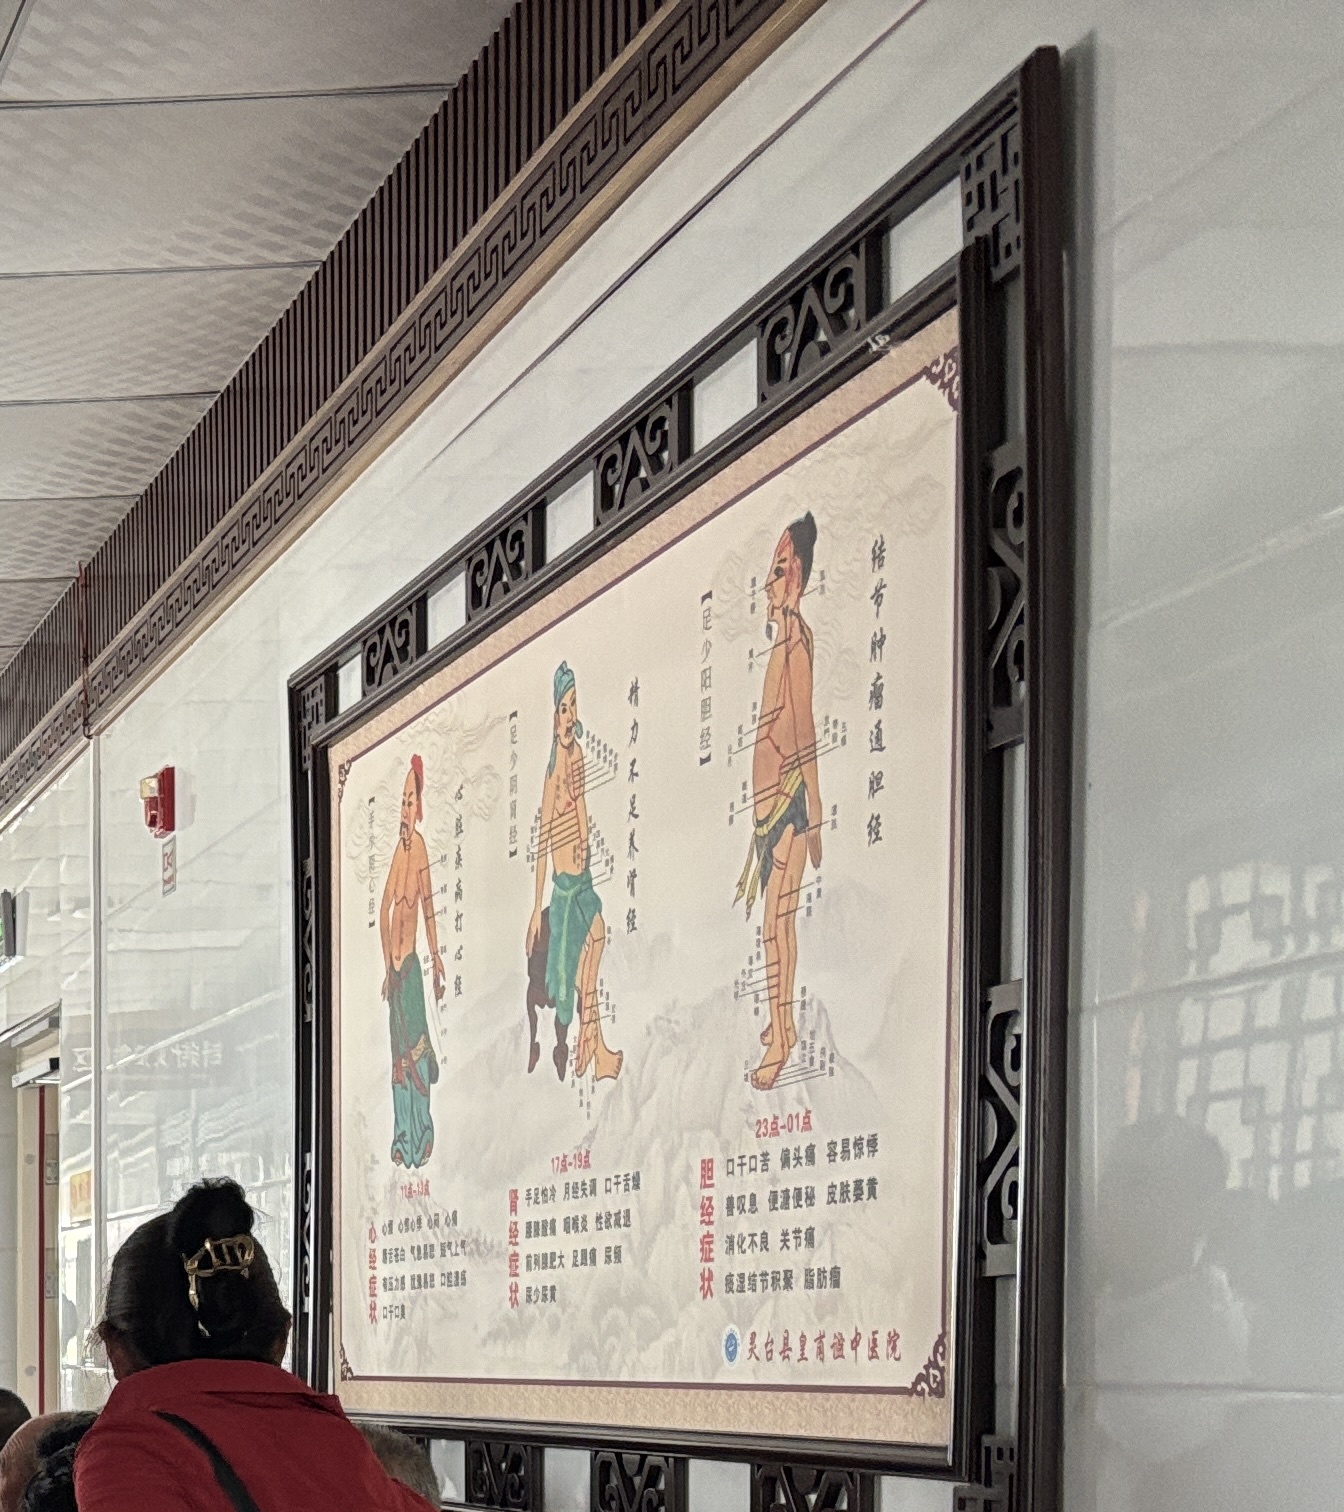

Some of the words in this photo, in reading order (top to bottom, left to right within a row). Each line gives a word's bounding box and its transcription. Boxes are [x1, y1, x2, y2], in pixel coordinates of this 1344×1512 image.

[755, 1108, 813, 1138] 23点-01点
[726, 1151, 770, 1177] 口干口苦
[780, 1143, 816, 1171] 偏头痛
[563, 1177, 597, 1201] 月经失调
[604, 1171, 641, 1195] 口干舌燥
[725, 1192, 758, 1217] 善叹息
[826, 1176, 879, 1205] 皮肤萎黄
[699, 1158, 715, 1300] 胆经症状
[725, 1230, 769, 1256] 消化不良
[779, 1225, 816, 1252] 关节痛
[508, 1188, 520, 1309] 肾经症状
[725, 1269, 793, 1294] 痰湿结节积聚
[803, 1265, 841, 1291] 脂肪瘤
[747, 1325, 902, 1365] 灵台县皇甫谧中医院
